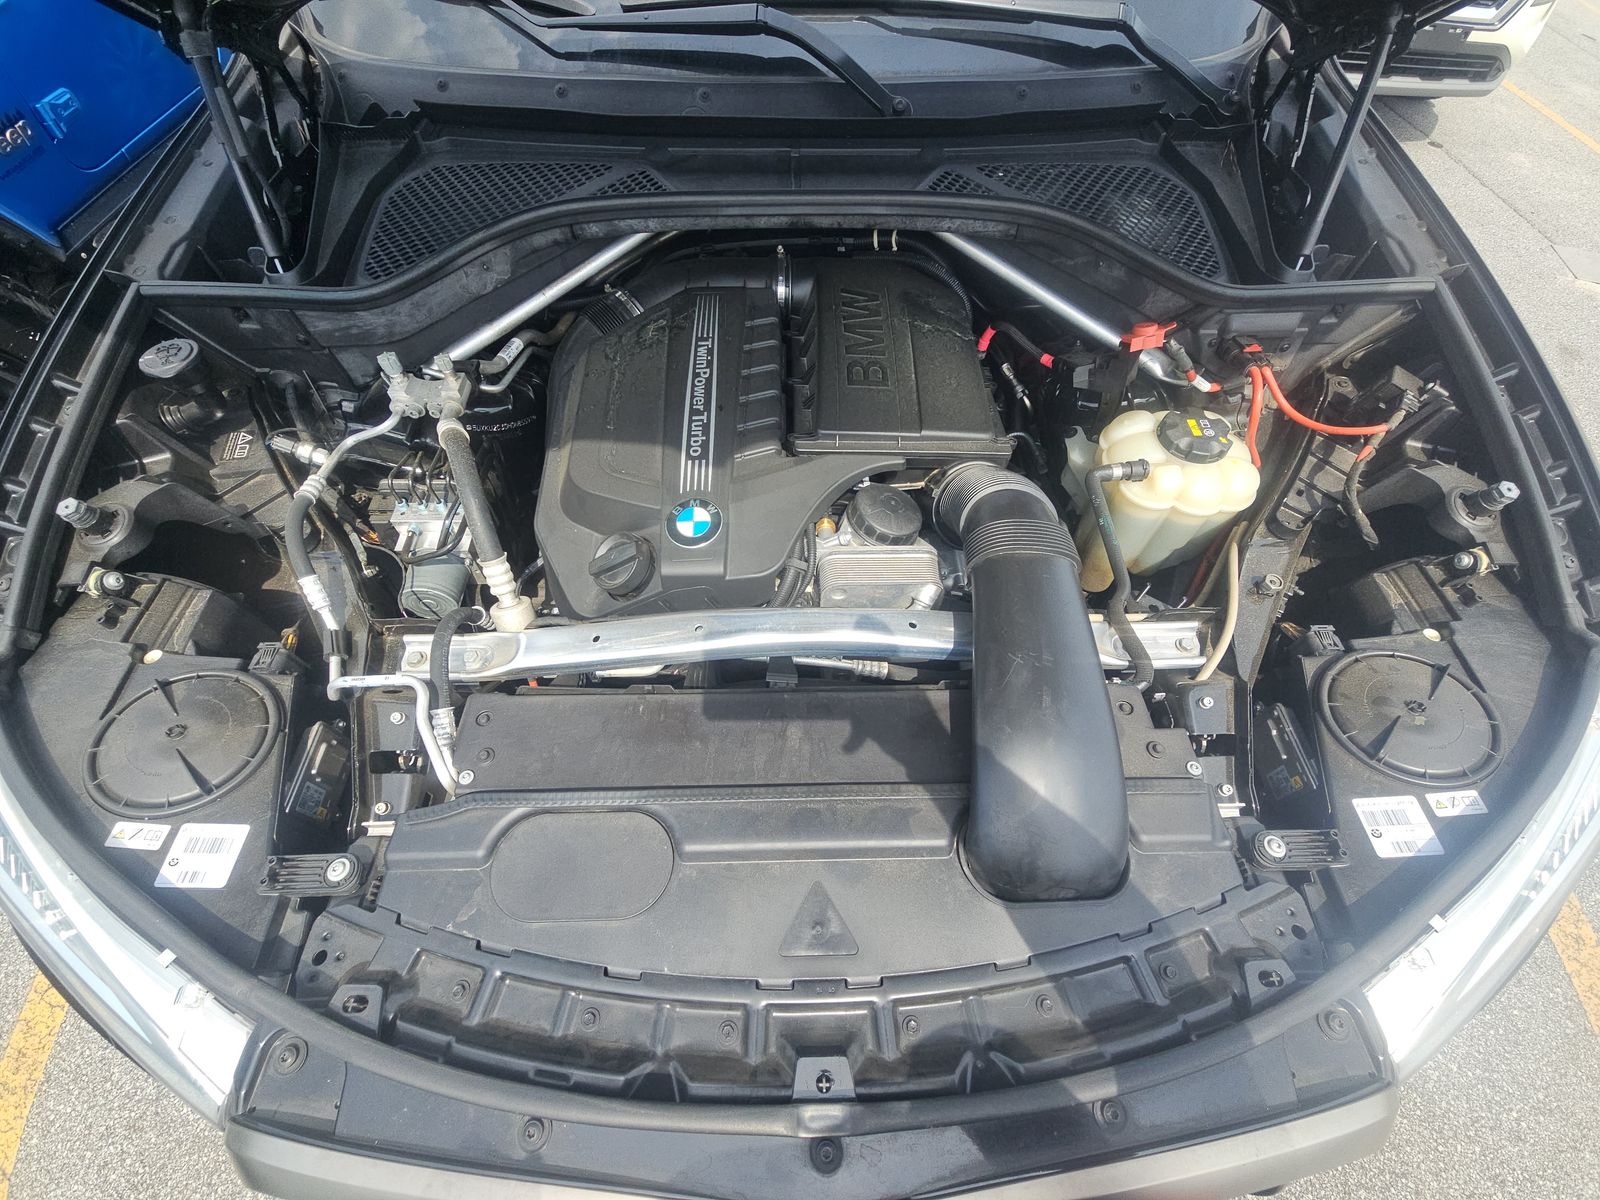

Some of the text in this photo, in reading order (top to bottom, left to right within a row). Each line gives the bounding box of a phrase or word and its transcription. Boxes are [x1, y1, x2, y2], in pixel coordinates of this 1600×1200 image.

[840, 288, 890, 389] BMW
[689, 338, 712, 457] TwinPower Turbo
[671, 499, 718, 516] BMW
